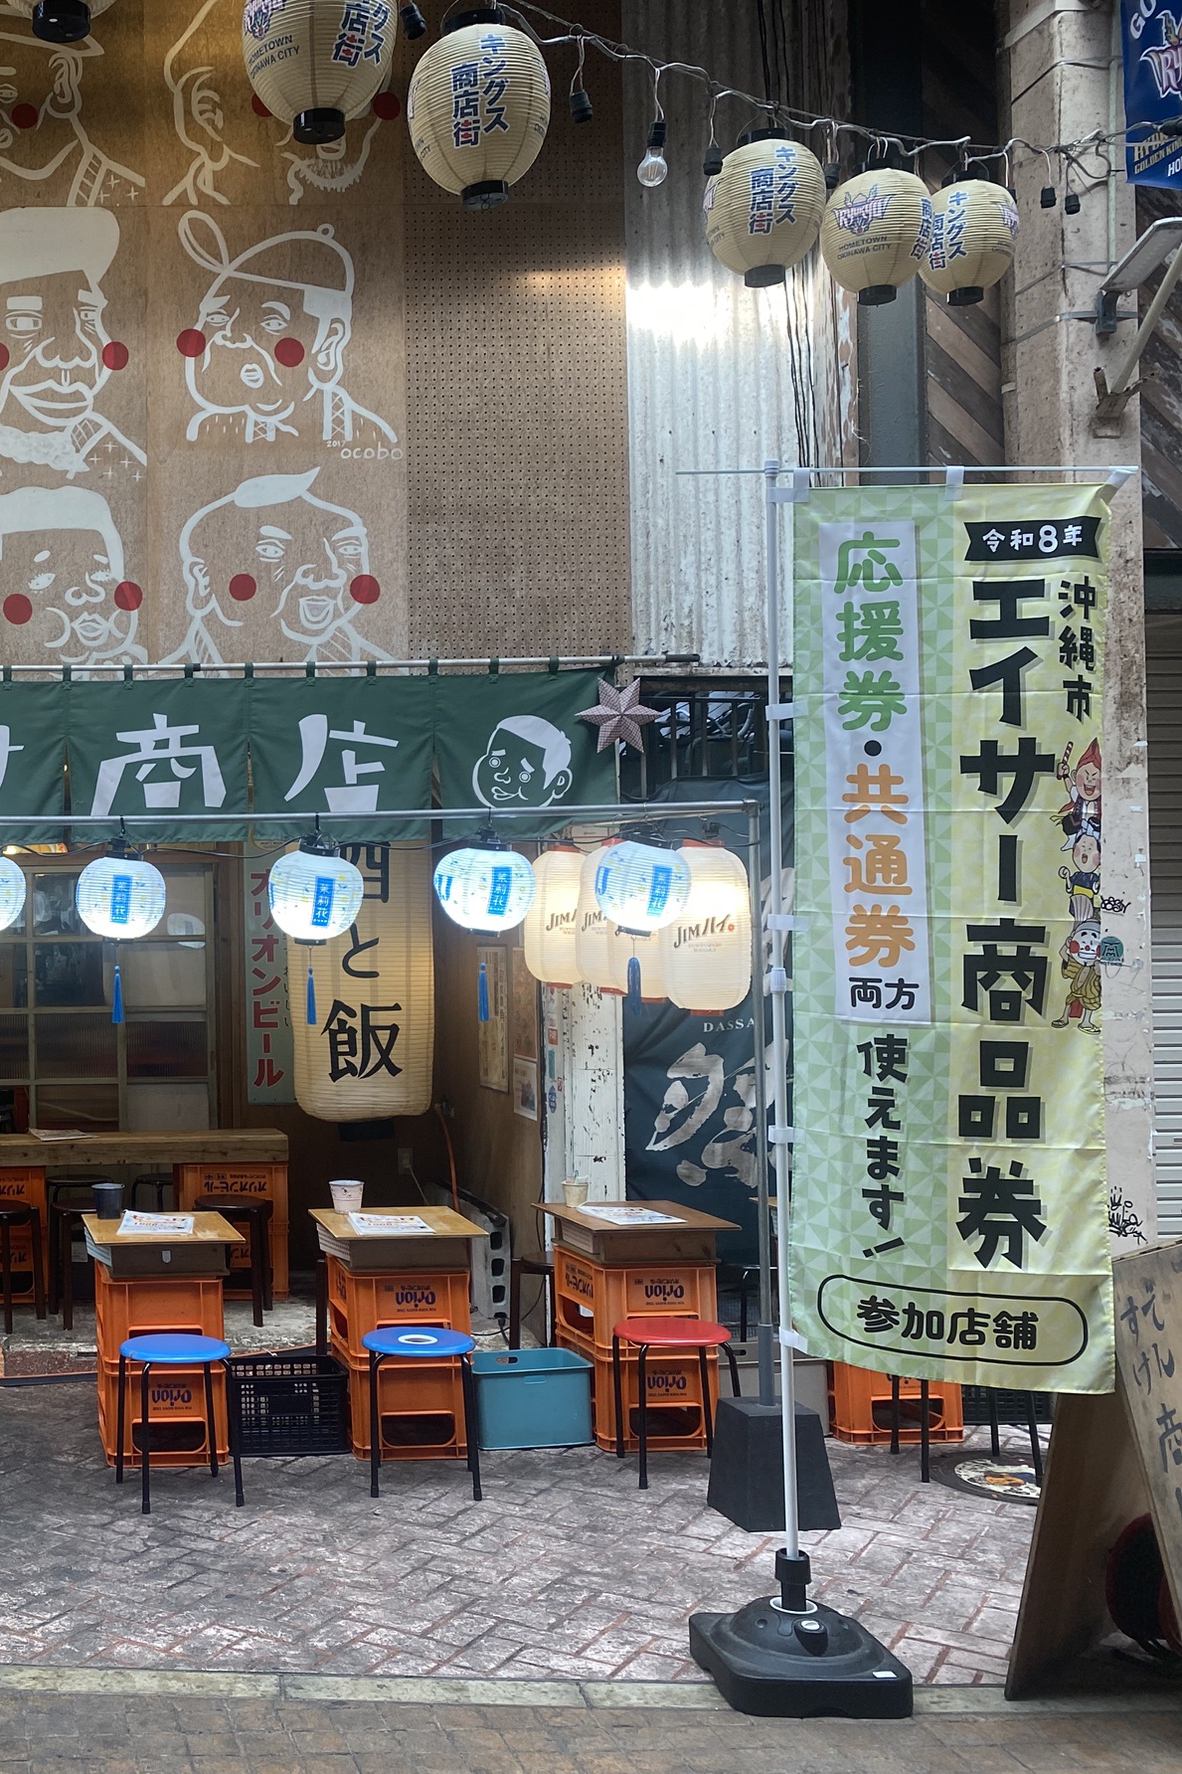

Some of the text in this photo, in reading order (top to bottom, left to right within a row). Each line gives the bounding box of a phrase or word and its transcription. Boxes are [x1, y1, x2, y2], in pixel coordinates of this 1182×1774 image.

[332, 0, 370, 67] 店街
[277, 46, 300, 63] CITY
[479, 34, 509, 133] キングス
[451, 63, 480, 147] 商店街
[749, 167, 775, 235] 商店街
[775, 146, 798, 225] キングス
[947, 192, 967, 260] キングス
[837, 243, 892, 260] OKINAWA CITY
[838, 235, 888, 252] HOMETOWN
[341, 441, 403, 460] ocobo
[981, 523, 1084, 554] 令和8年
[1058, 576, 1097, 722] 沖縄市
[834, 531, 916, 968] 応援券・共通券
[315, 883, 331, 918] 茉莉花
[958, 578, 1055, 1269] エイサー商品券
[849, 977, 919, 1010] 両方
[703, 1017, 756, 1033] DASSA
[857, 1034, 908, 1258] 使えます!
[204, 1181, 267, 1193] オリオンビール
[395, 1291, 436, 1308] Orion
[644, 1285, 685, 1302] Orion
[856, 1295, 1040, 1351] 参加店舗
[151, 1389, 192, 1407] Orion
[647, 1376, 687, 1393] Orion
